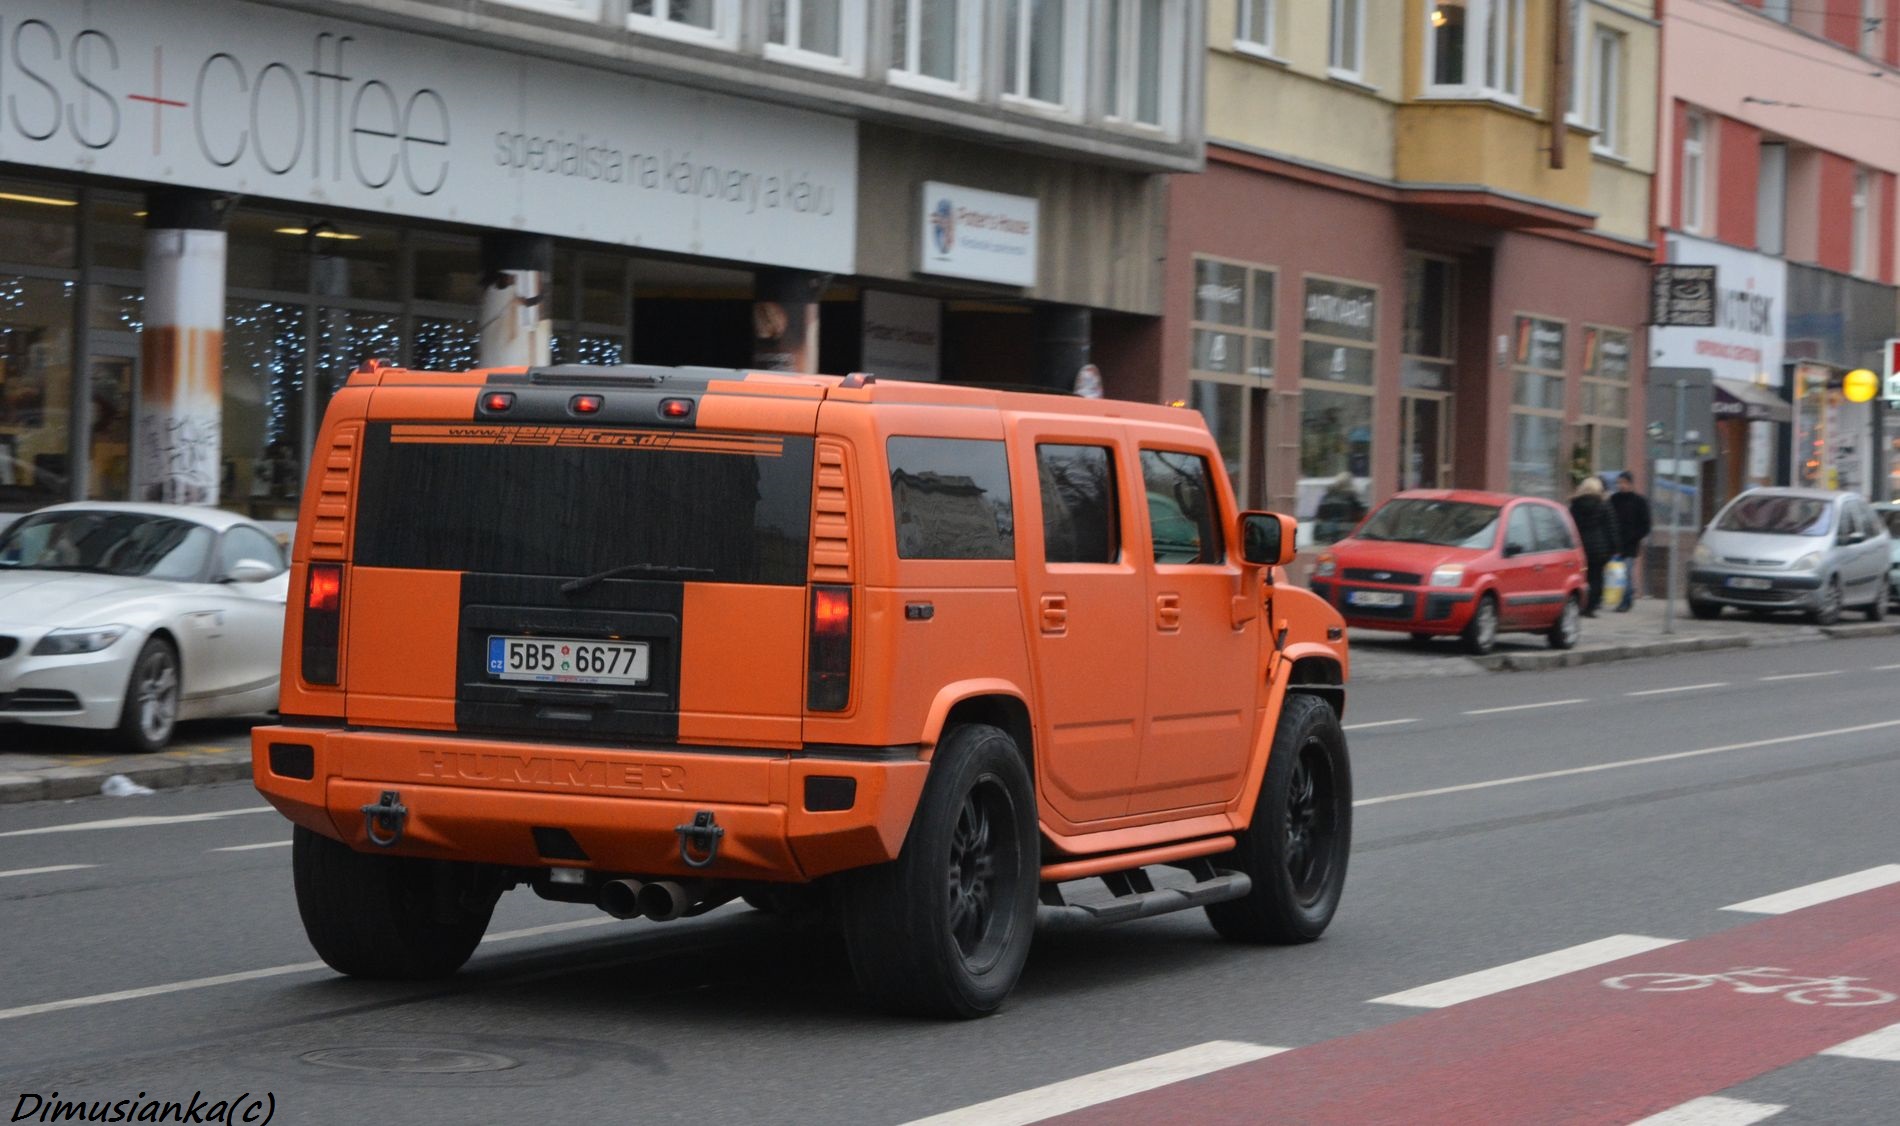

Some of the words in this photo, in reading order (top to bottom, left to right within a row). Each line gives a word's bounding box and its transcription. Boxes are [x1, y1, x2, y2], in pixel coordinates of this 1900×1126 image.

[494, 130, 623, 183] specialista
[628, 152, 658, 189] na
[764, 176, 779, 208] a
[490, 660, 503, 669] CZ
[509, 642, 555, 671] 5B5
[575, 646, 637, 675] 6677
[418, 750, 687, 792] HUMMER
